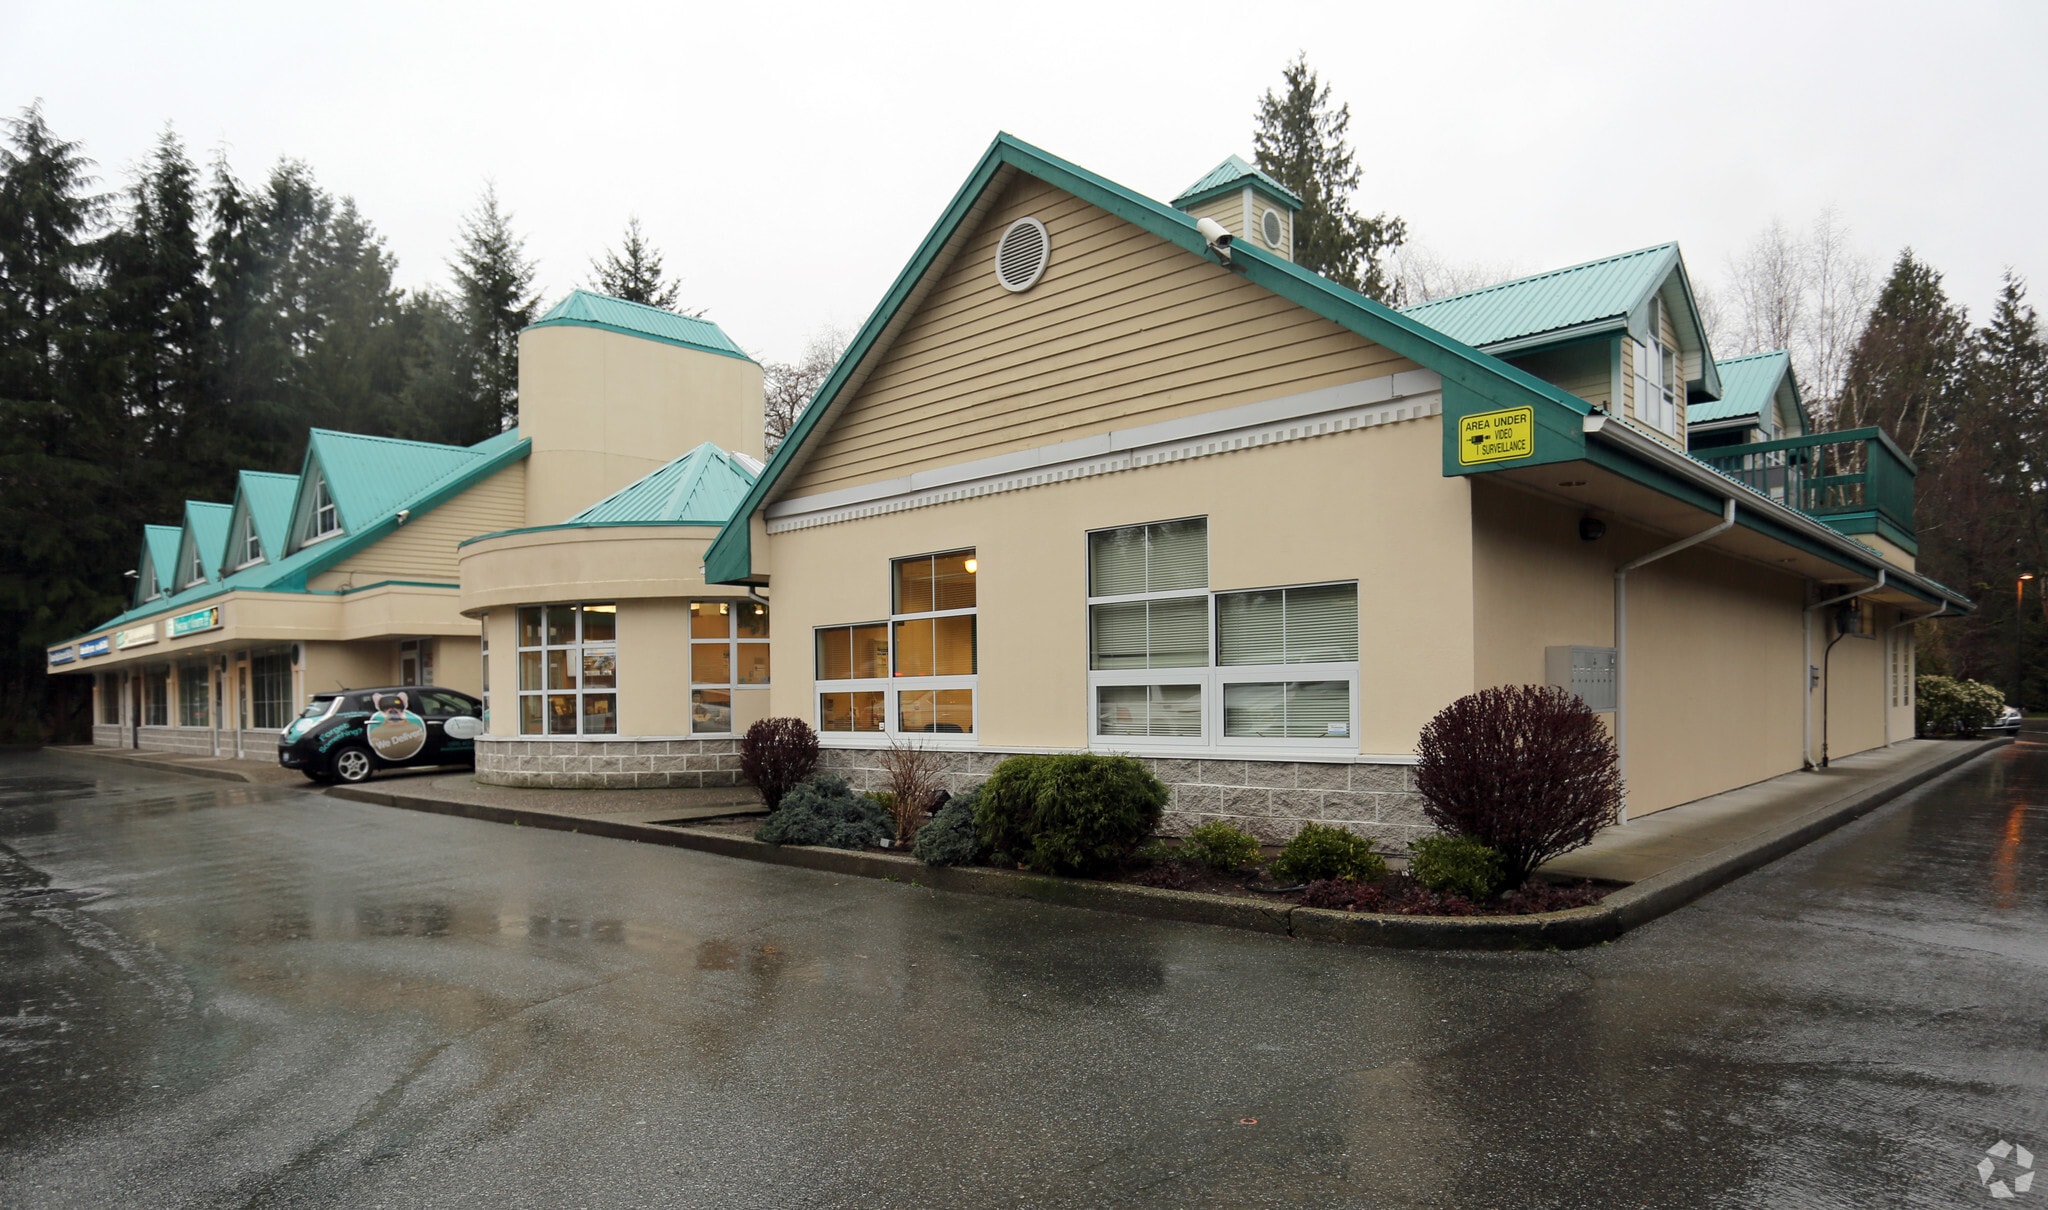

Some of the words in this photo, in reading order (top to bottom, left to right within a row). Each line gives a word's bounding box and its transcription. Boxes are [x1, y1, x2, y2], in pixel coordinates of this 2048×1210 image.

[1466, 420, 1490, 431] AREA
[1494, 414, 1526, 427] UNDER
[1495, 428, 1512, 440] VIDEO
[1482, 440, 1526, 455] SURVEILLANCE
[375, 739, 391, 750] We
